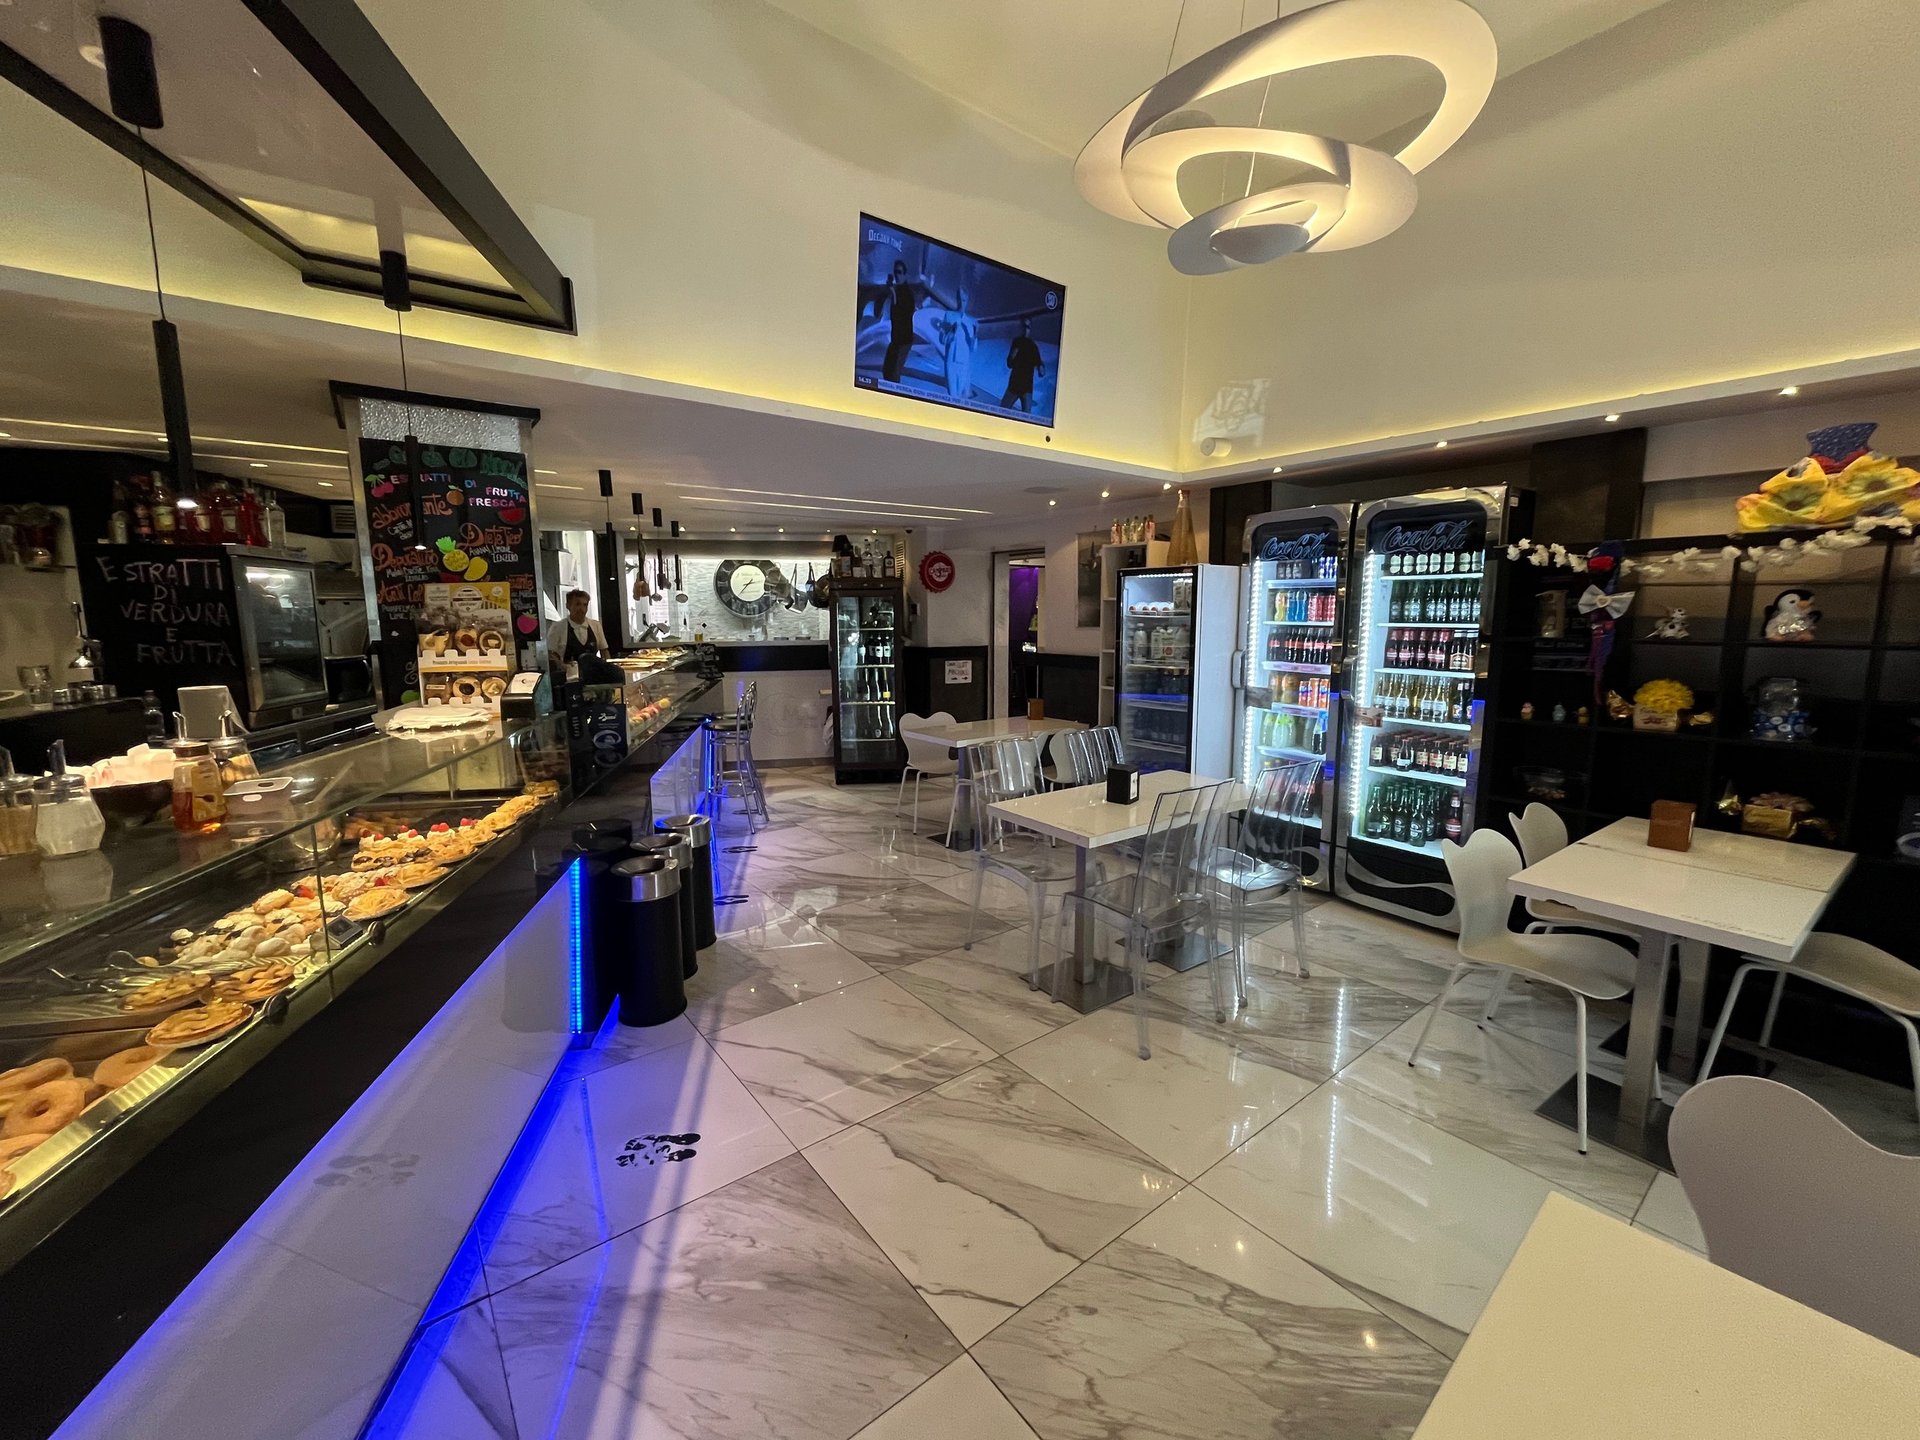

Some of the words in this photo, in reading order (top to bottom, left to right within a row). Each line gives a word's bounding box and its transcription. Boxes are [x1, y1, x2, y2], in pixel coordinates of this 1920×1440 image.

[390, 473, 451, 485] ESATTI
[464, 479, 477, 489] DI
[469, 497, 517, 508] FRESCA
[486, 486, 528, 503] FRUTTA
[120, 600, 231, 627] VERDURA
[166, 627, 179, 642] E
[137, 641, 237, 667] FRUTTA
